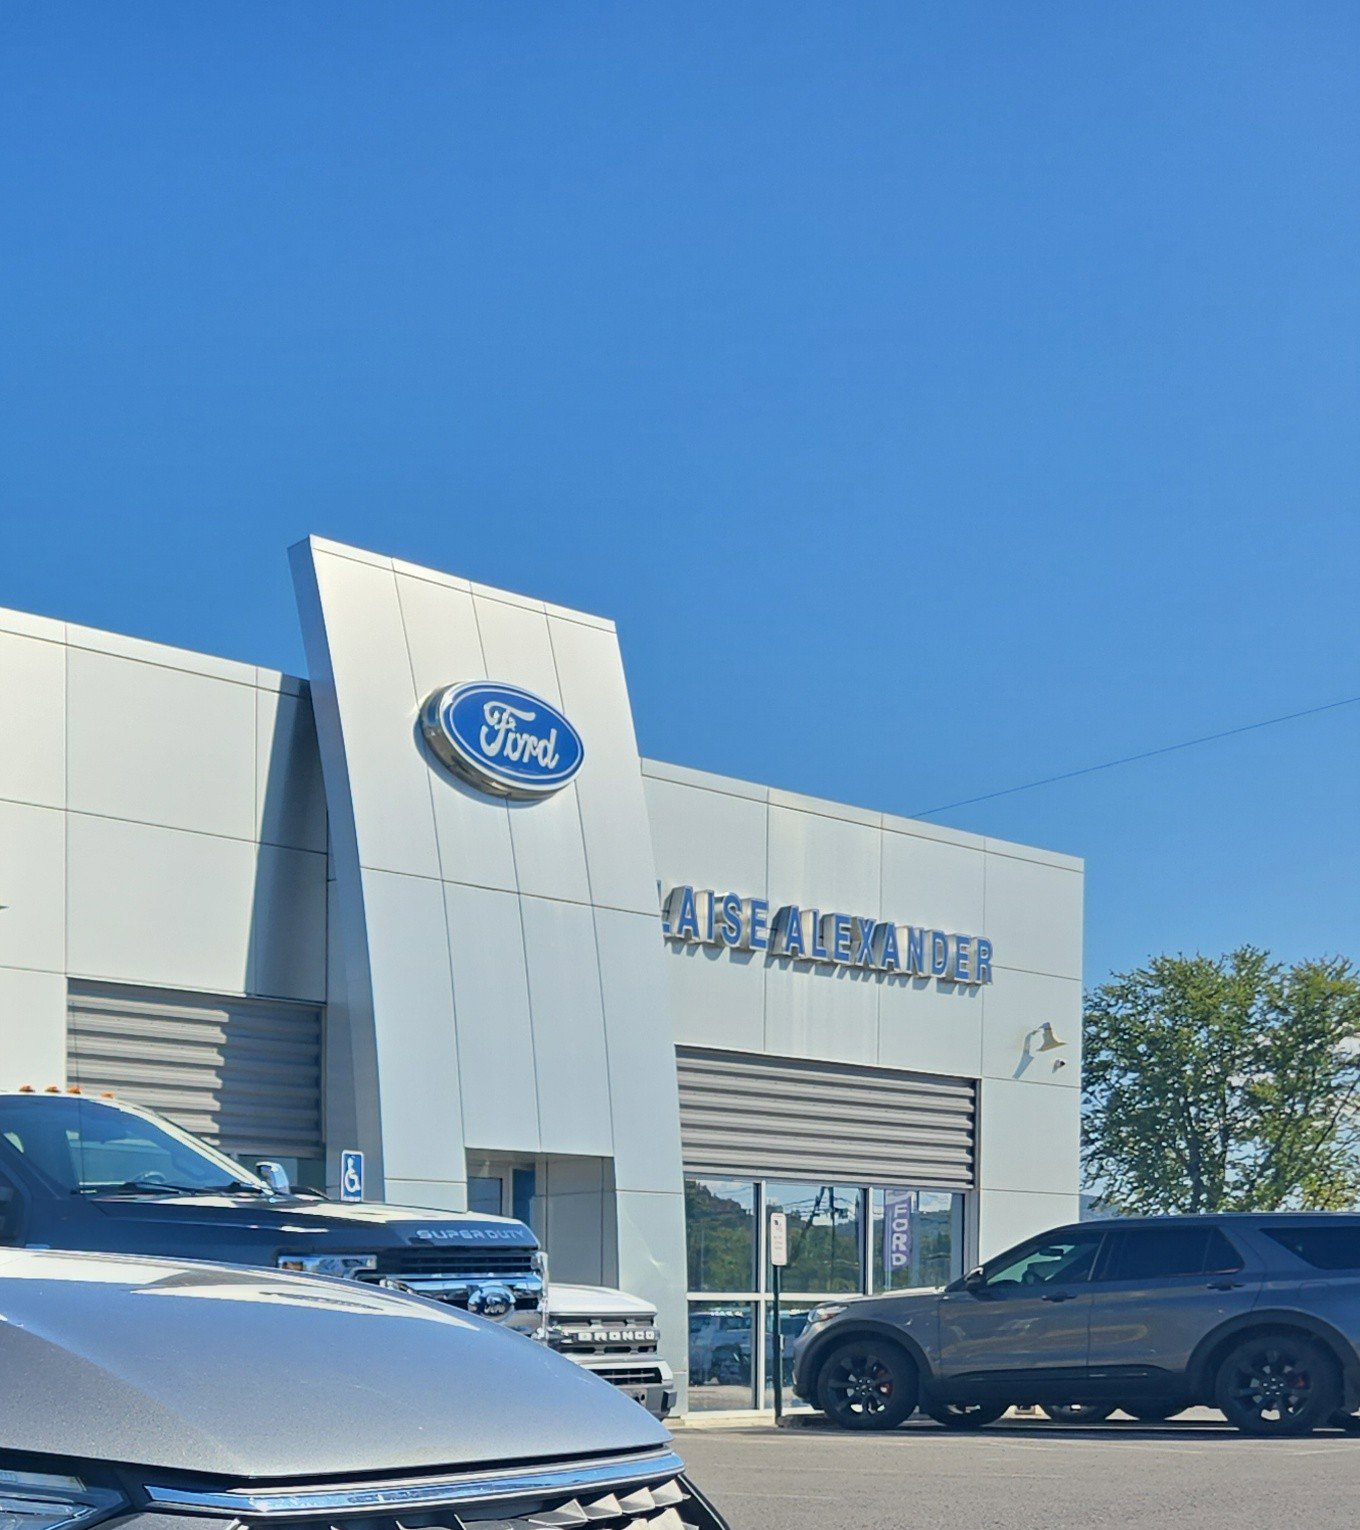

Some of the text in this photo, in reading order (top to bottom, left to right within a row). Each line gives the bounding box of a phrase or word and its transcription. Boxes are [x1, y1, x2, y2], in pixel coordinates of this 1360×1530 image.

[480, 700, 559, 770] Ford
[661, 884, 994, 985] AISE ALEXANDER
[416, 1229, 525, 1240] SUPER DUTY
[891, 1202, 909, 1267] FORD
[578, 1330, 655, 1342] BRONCO
